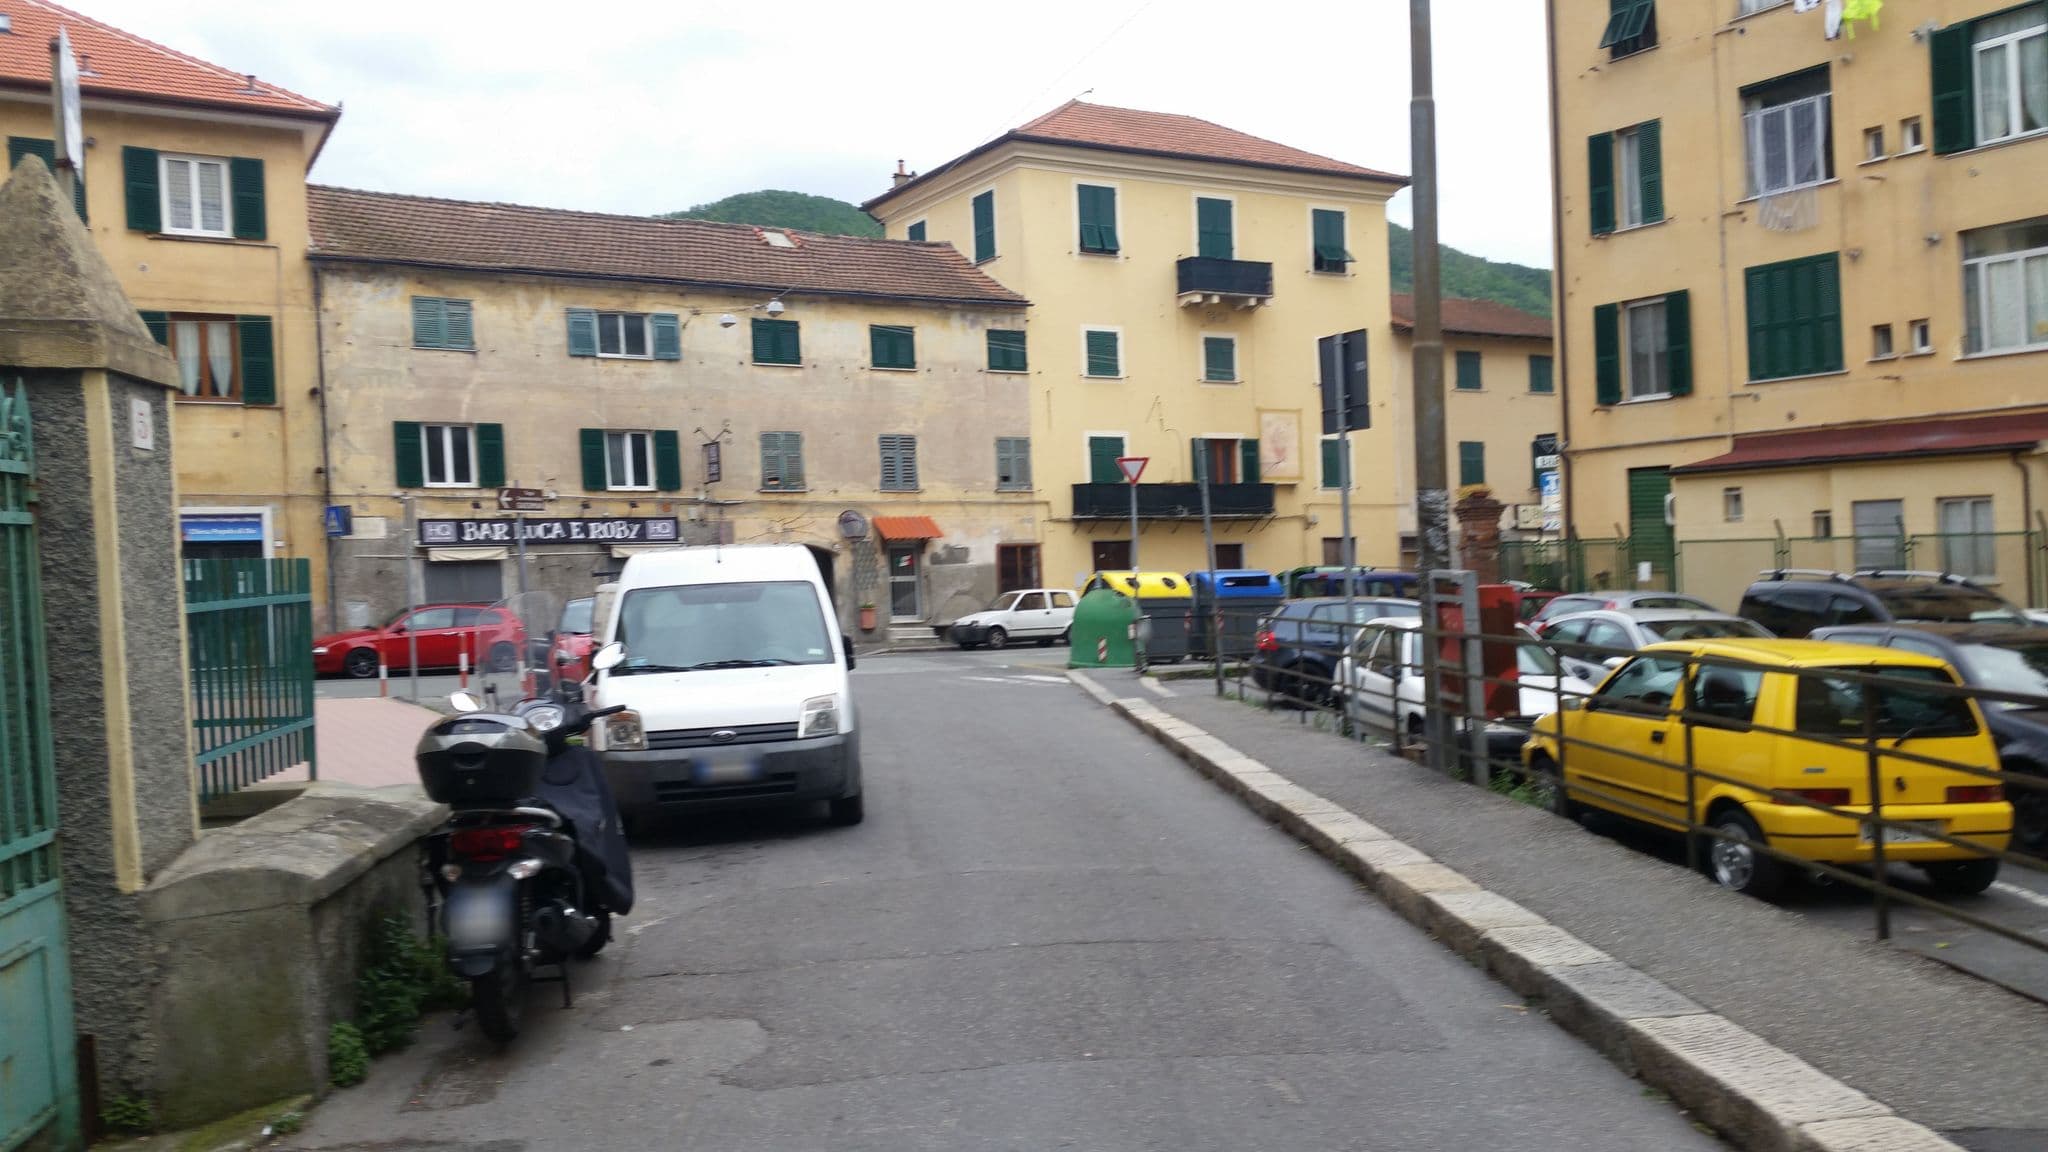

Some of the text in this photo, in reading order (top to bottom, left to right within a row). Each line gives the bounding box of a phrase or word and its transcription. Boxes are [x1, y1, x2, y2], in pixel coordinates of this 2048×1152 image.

[461, 521, 511, 540] BAR
[512, 522, 567, 539] LUCA
[568, 521, 586, 539] E
